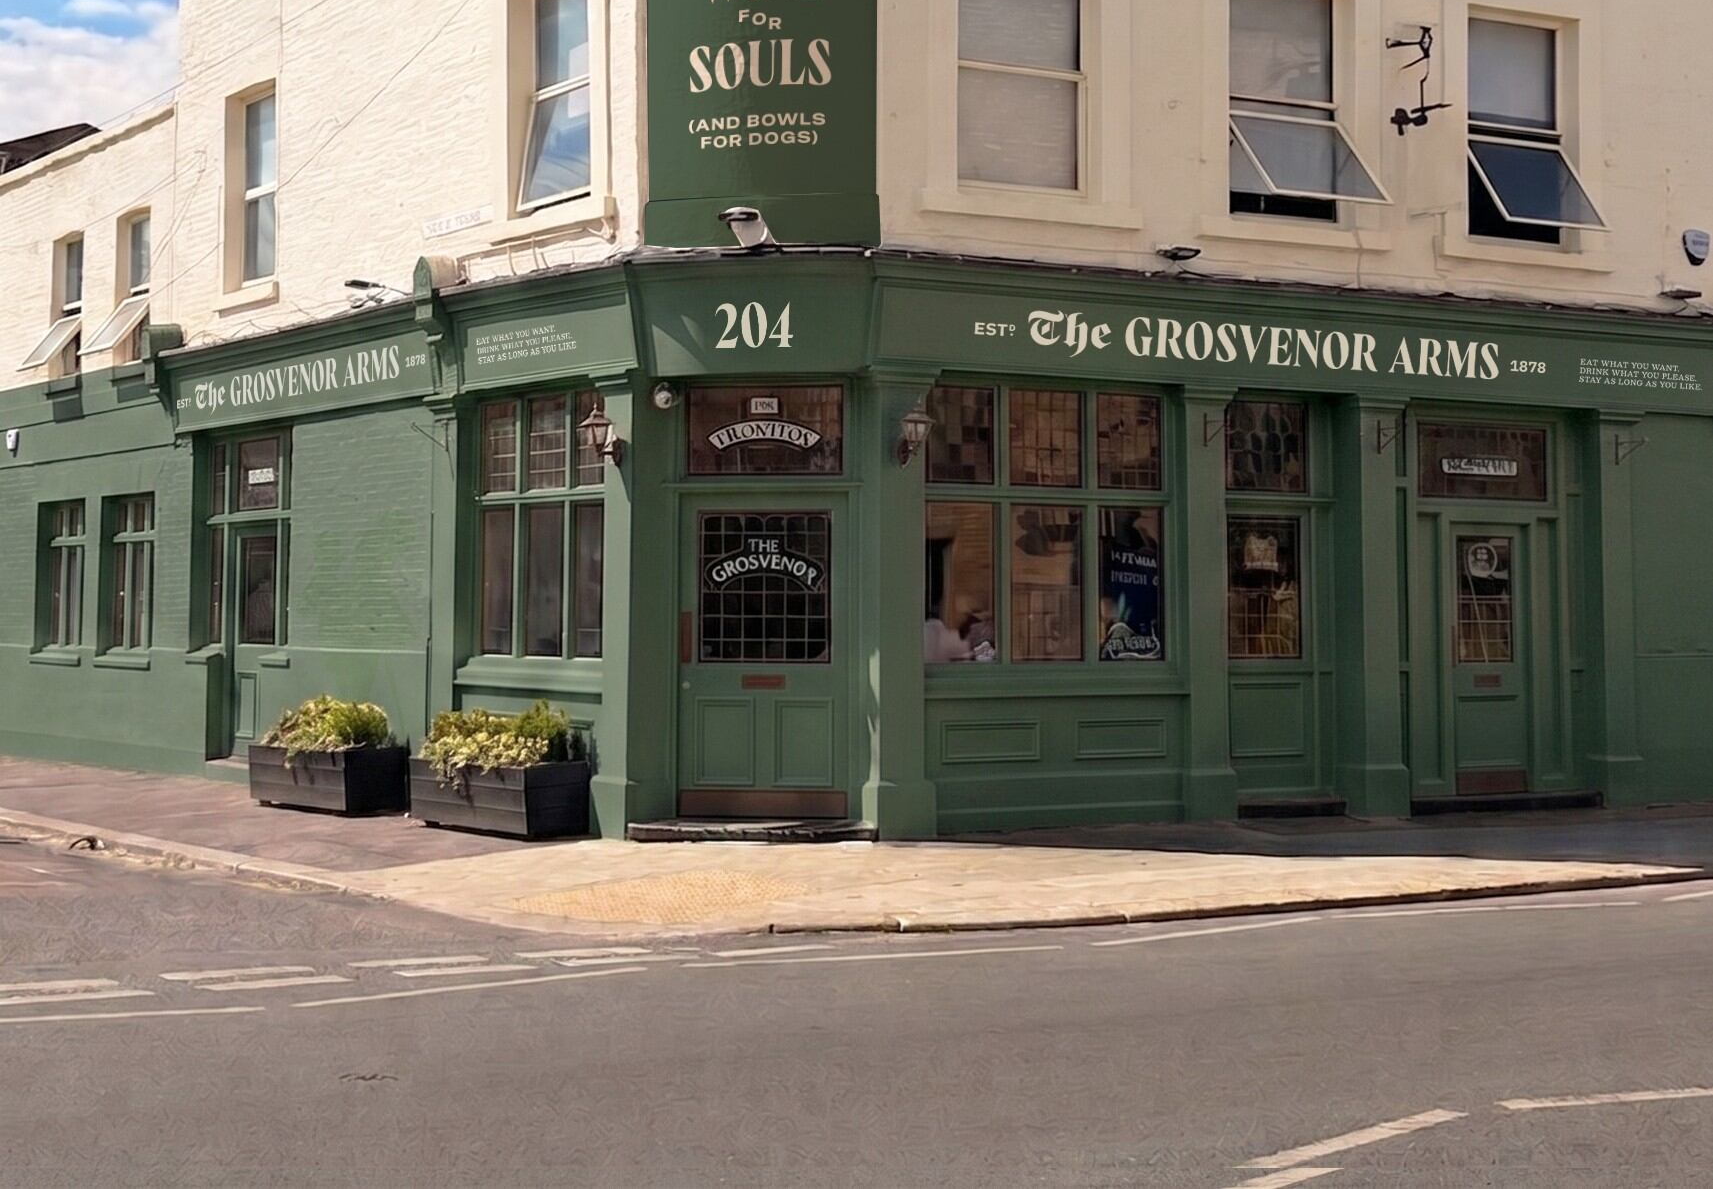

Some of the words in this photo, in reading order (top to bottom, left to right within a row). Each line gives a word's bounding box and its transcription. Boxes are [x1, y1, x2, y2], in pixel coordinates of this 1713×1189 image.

[738, 9, 782, 30] FOR
[688, 38, 832, 93] SOULS
[688, 116, 741, 134] (AND
[747, 113, 826, 128] BOWLS
[700, 135, 742, 149] FOR
[748, 130, 818, 146] DOGS)
[714, 301, 794, 349] 204
[476, 336, 490, 346] EAT
[492, 331, 514, 343] WHAT
[515, 329, 530, 339] YOU
[477, 345, 500, 355] DRINK
[501, 340, 524, 351] WHAT
[525, 337, 540, 347] YOU
[1028, 310, 1112, 358] The
[1125, 316, 1378, 372] GROSVENOR
[1388, 337, 1500, 380] ARMS
[1510, 360, 1546, 374] 1878
[477, 354, 495, 365] STAY
[497, 352, 507, 362] AS
[508, 349, 529, 360] LONG
[530, 347, 540, 357] AS
[541, 344, 557, 355] YOU
[1580, 358, 1598, 366] EAT
[1601, 359, 1629, 369] WHAT
[1631, 362, 1649, 370] YOU
[195, 380, 226, 419] The
[230, 358, 339, 407] GROSVENOR
[343, 345, 400, 387] ARMS
[405, 353, 426, 368] 1878
[1578, 376, 1601, 384] STAY
[1604, 377, 1616, 385] AS
[1618, 378, 1643, 387] LONG
[1645, 380, 1657, 388] AS
[1660, 381, 1677, 389] YOU
[1579, 367, 1609, 376] DRINK
[1612, 369, 1639, 378] WHAT
[1642, 371, 1660, 380] YOU
[748, 538, 780, 553] THE
